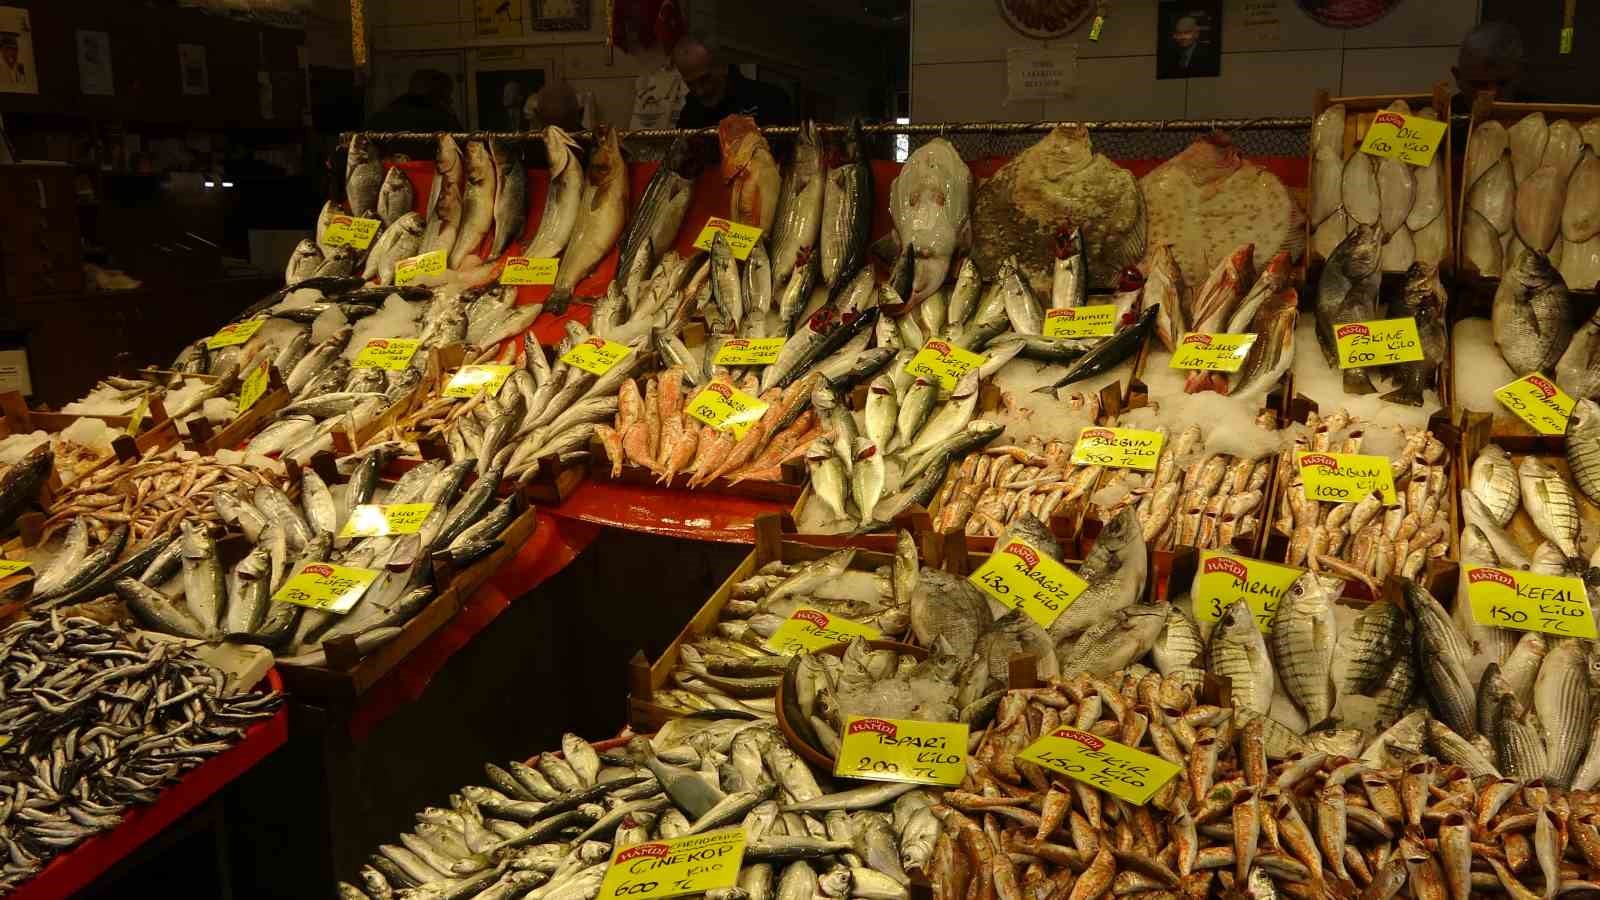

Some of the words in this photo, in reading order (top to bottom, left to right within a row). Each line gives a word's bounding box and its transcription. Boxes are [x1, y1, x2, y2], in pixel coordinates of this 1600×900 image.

[1348, 350, 1376, 364] 600
[1314, 484, 1349, 498] 1000
[981, 570, 1010, 594] 430
[1013, 561, 1069, 600] KARAGÖZ
[1013, 594, 1026, 609] TL
[1516, 583, 1584, 604] KEFAL
[1489, 604, 1528, 623] 150
[1538, 618, 1570, 632] TL
[856, 756, 899, 773] 200
[912, 768, 941, 779] TL
[1036, 751, 1086, 773] 450
[1090, 773, 1113, 787] TL
[615, 880, 659, 897] 600
